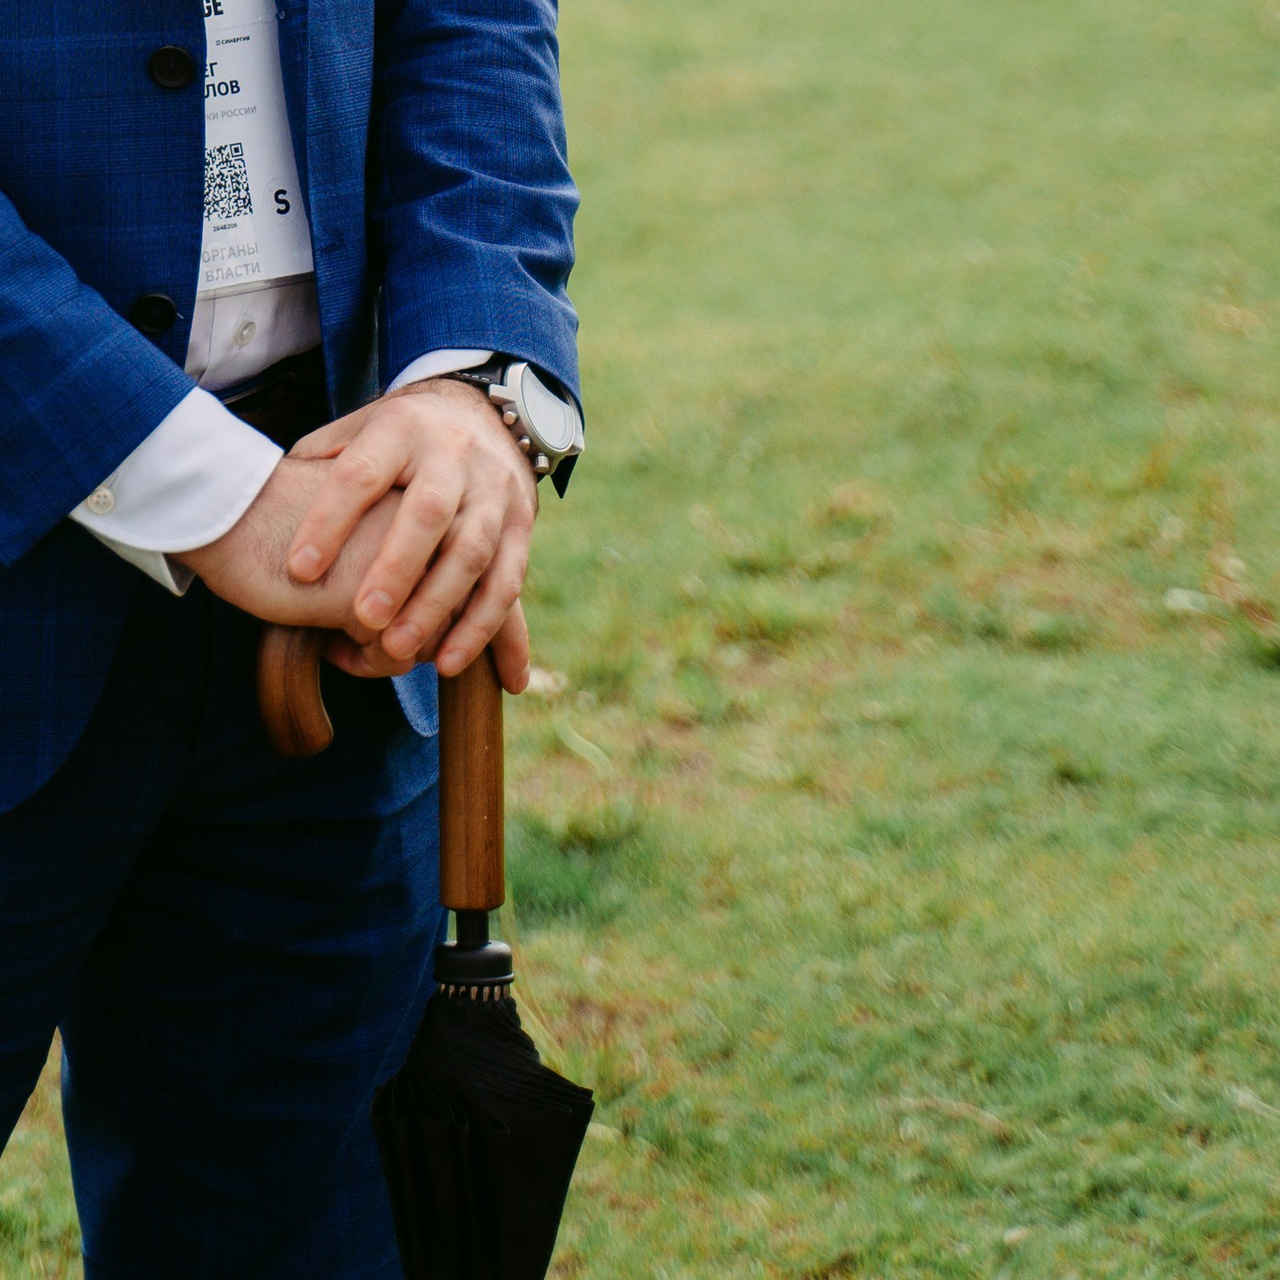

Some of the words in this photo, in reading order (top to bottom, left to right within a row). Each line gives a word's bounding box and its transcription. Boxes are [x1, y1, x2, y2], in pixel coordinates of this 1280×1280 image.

[221, 105, 258, 119] РОССИИ
[274, 189, 291, 215] S
[201, 242, 259, 264] ОРГАНЫ
[205, 261, 261, 283] ВЛАСТИ
